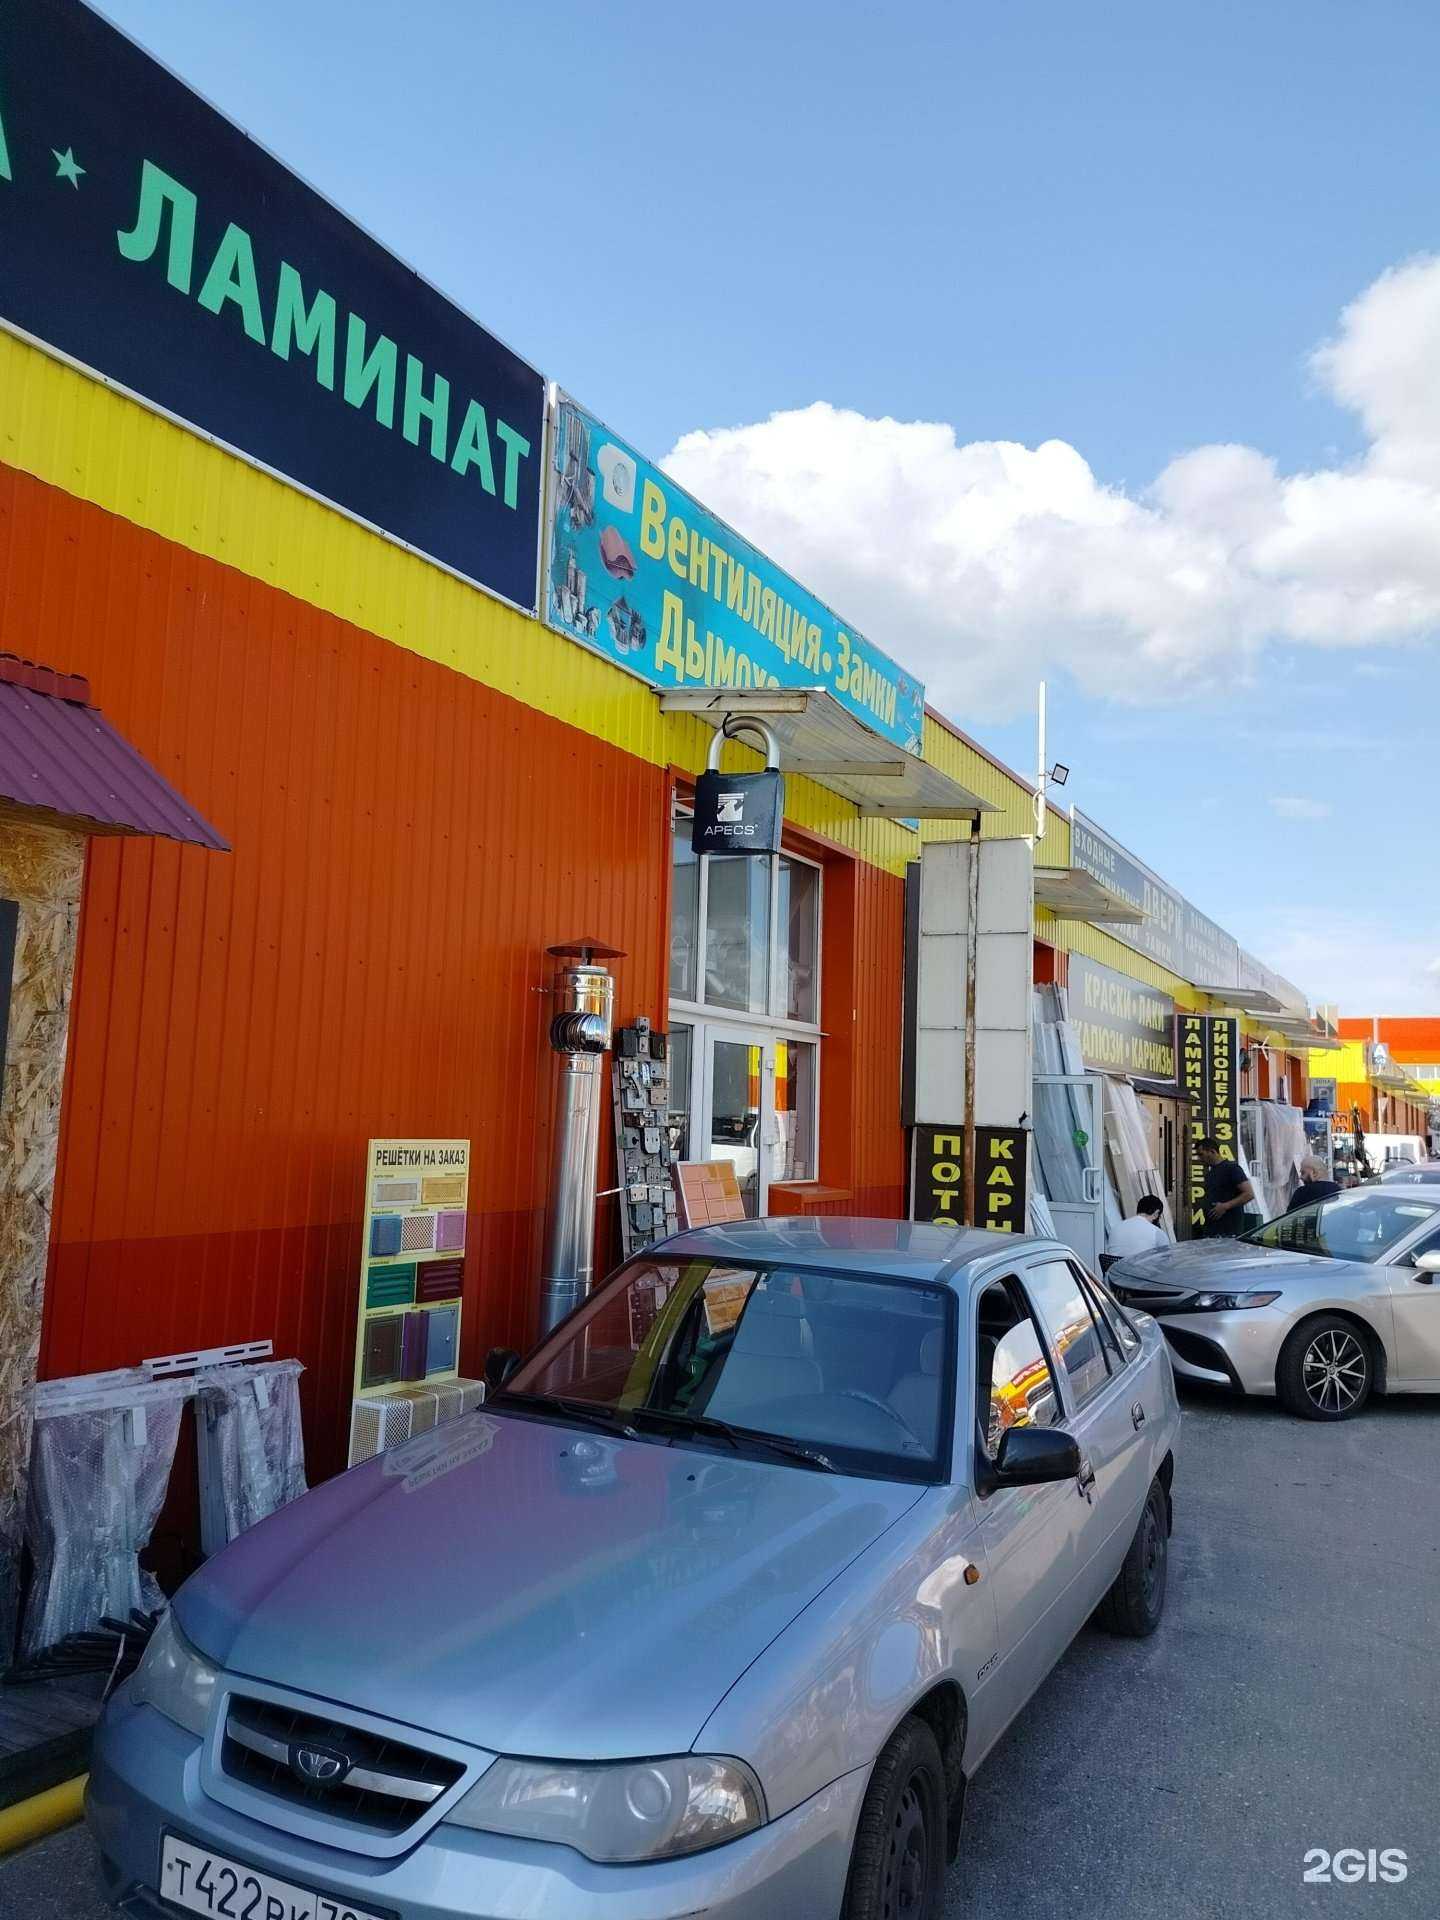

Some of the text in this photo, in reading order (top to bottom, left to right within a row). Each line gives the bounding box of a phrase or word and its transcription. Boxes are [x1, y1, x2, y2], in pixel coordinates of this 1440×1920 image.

[117, 159, 530, 511] ЛАМИНАТ
[640, 478, 897, 729] Вентиляция Замки
[655, 589, 780, 688] Дымо
[704, 825, 755, 836] APECS
[1073, 827, 1116, 873] ВХОДНЫЕ
[1143, 879, 1182, 944] ДВЕРИ
[1084, 971, 1165, 1032] КРАСКИ ЛАКИ
[1131, 1036, 1174, 1076] КАРНИЗЫ
[1213, 1020, 1230, 1119] ЛИНОЛЕУМ
[423, 1150, 436, 1166] НА
[438, 1149, 466, 1165] ЗАКАЗ
[1191, 1122, 1206, 1226] ДЕРИ
